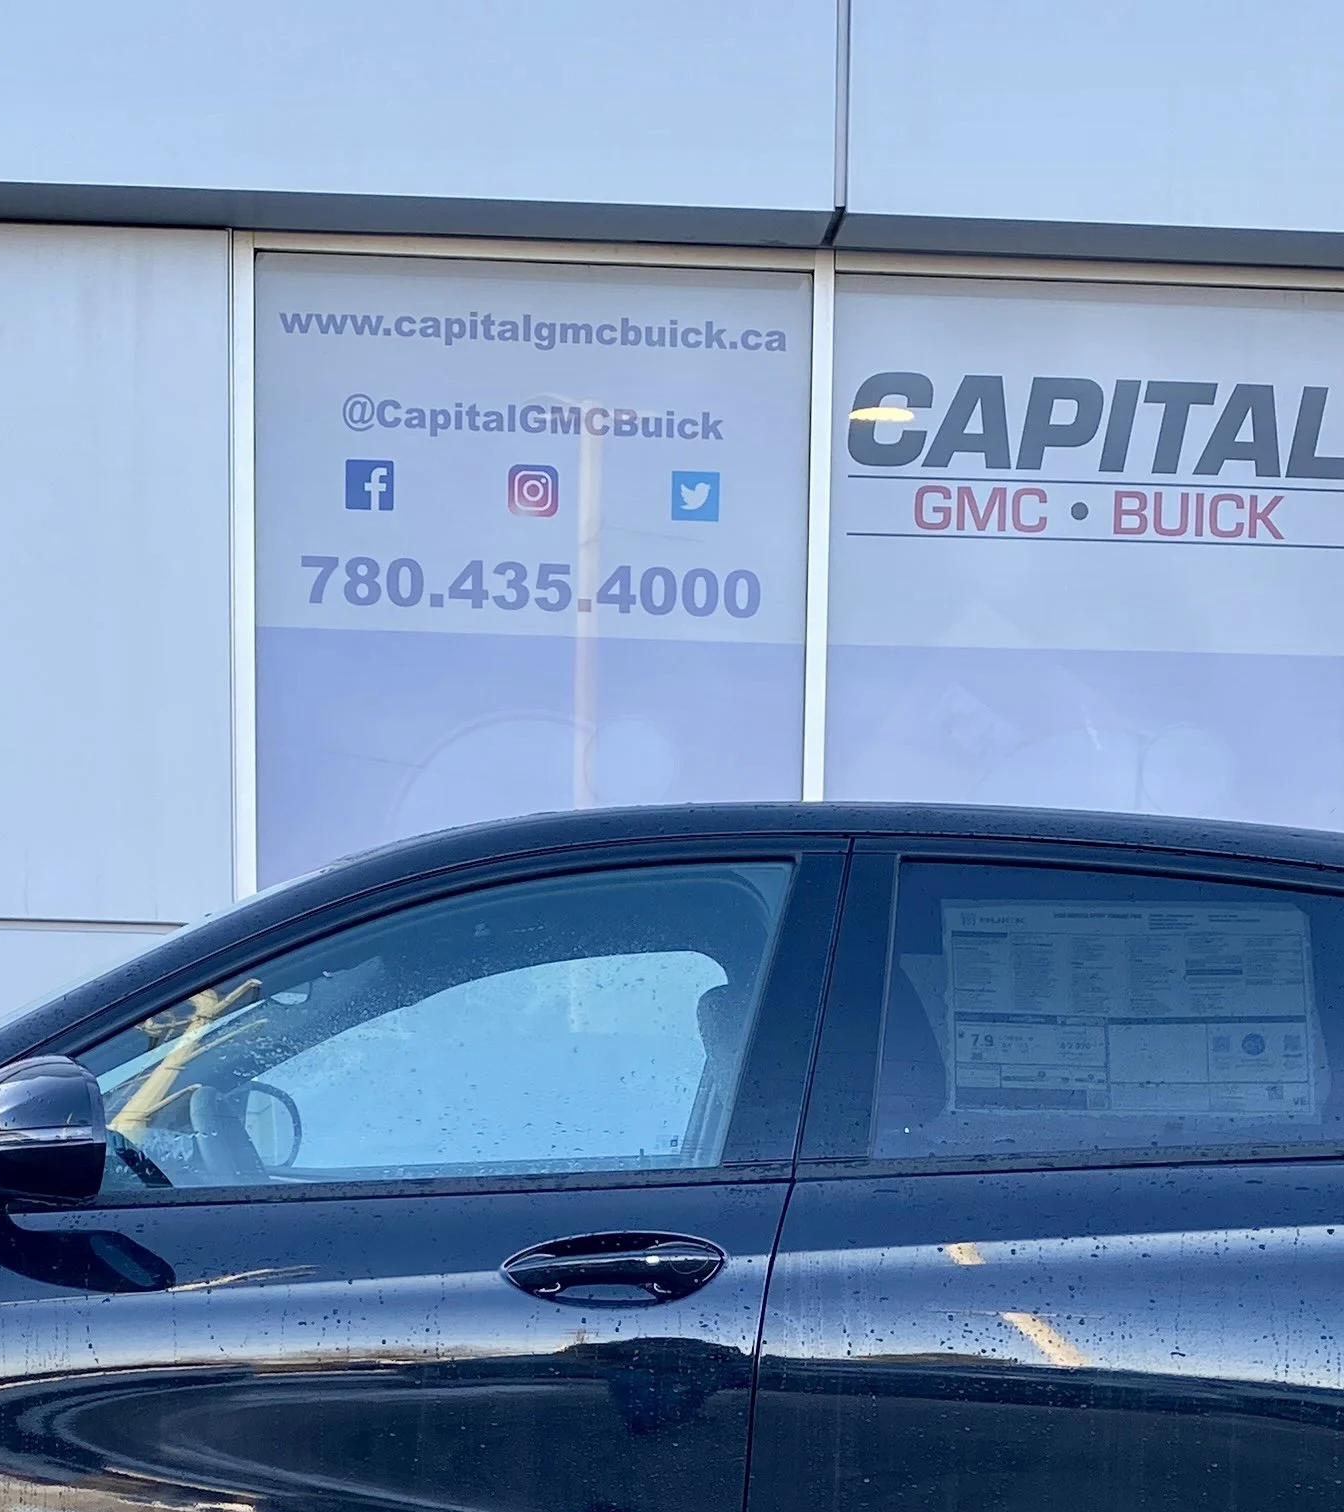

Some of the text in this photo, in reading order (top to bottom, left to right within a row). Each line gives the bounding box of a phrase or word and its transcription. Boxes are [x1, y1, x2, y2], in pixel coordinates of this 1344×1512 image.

[279, 310, 787, 353] www.capitalgmcbuick.ca
[342, 393, 723, 440] @CapitalGMCBuick
[914, 484, 1285, 540] GMC BUICK
[300, 555, 762, 619] 780.435.4000
